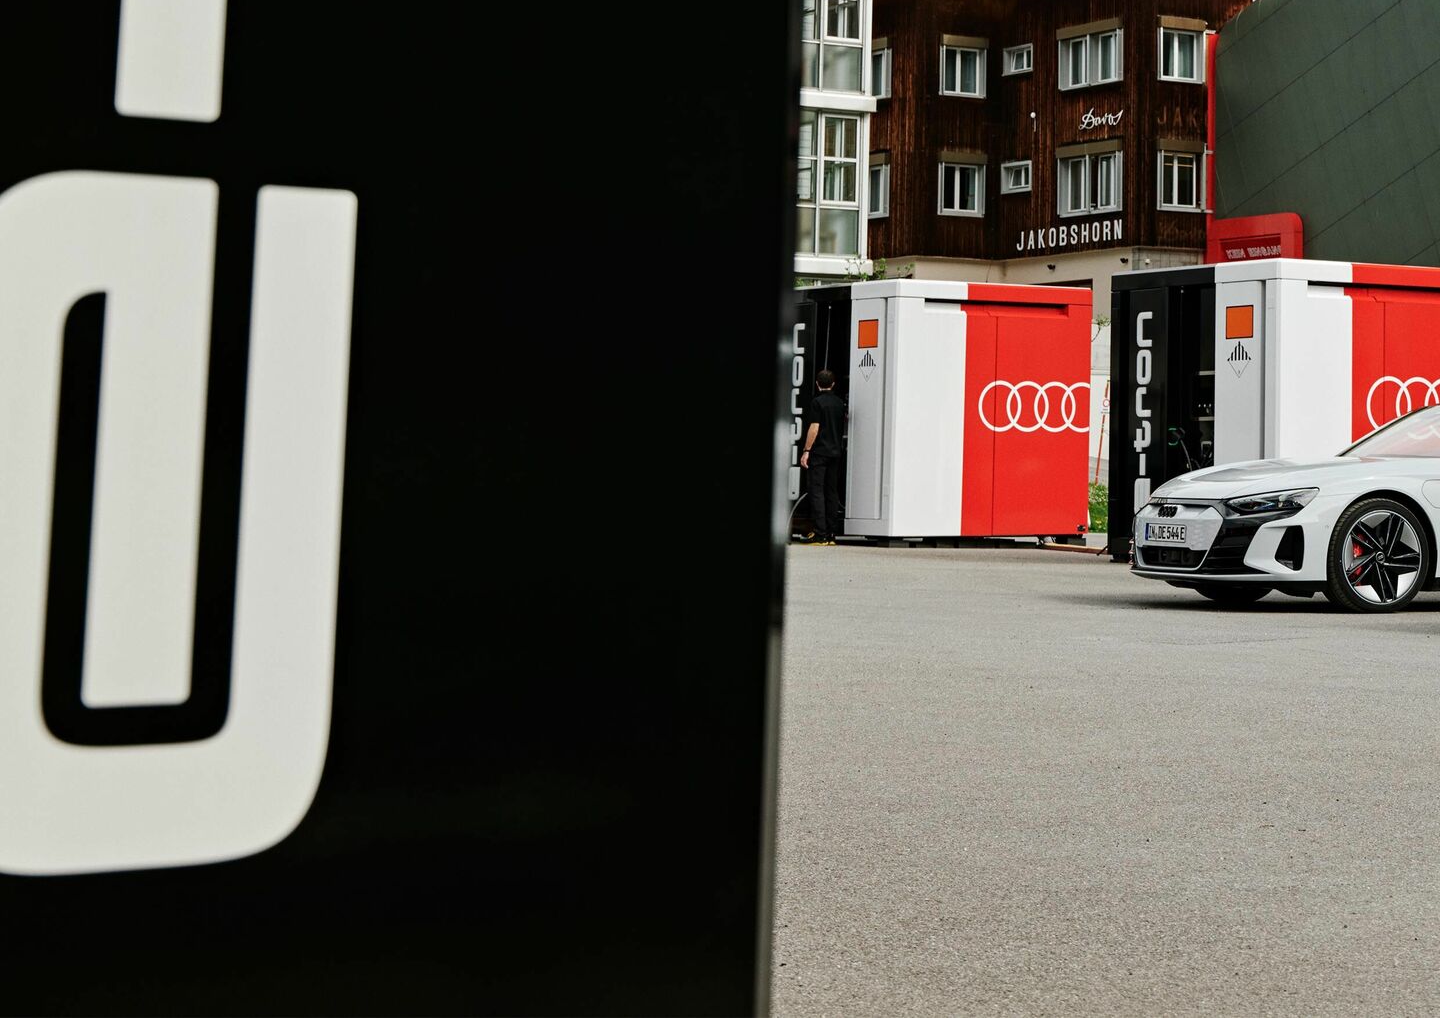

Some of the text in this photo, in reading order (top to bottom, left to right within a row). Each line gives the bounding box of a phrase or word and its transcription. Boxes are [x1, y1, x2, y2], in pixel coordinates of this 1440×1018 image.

[1078, 107, 1124, 131] Davos
[1157, 103, 1207, 128] JAK
[1016, 219, 1123, 251] JAKOBSHORN
[1133, 311, 1153, 515] e-tron
